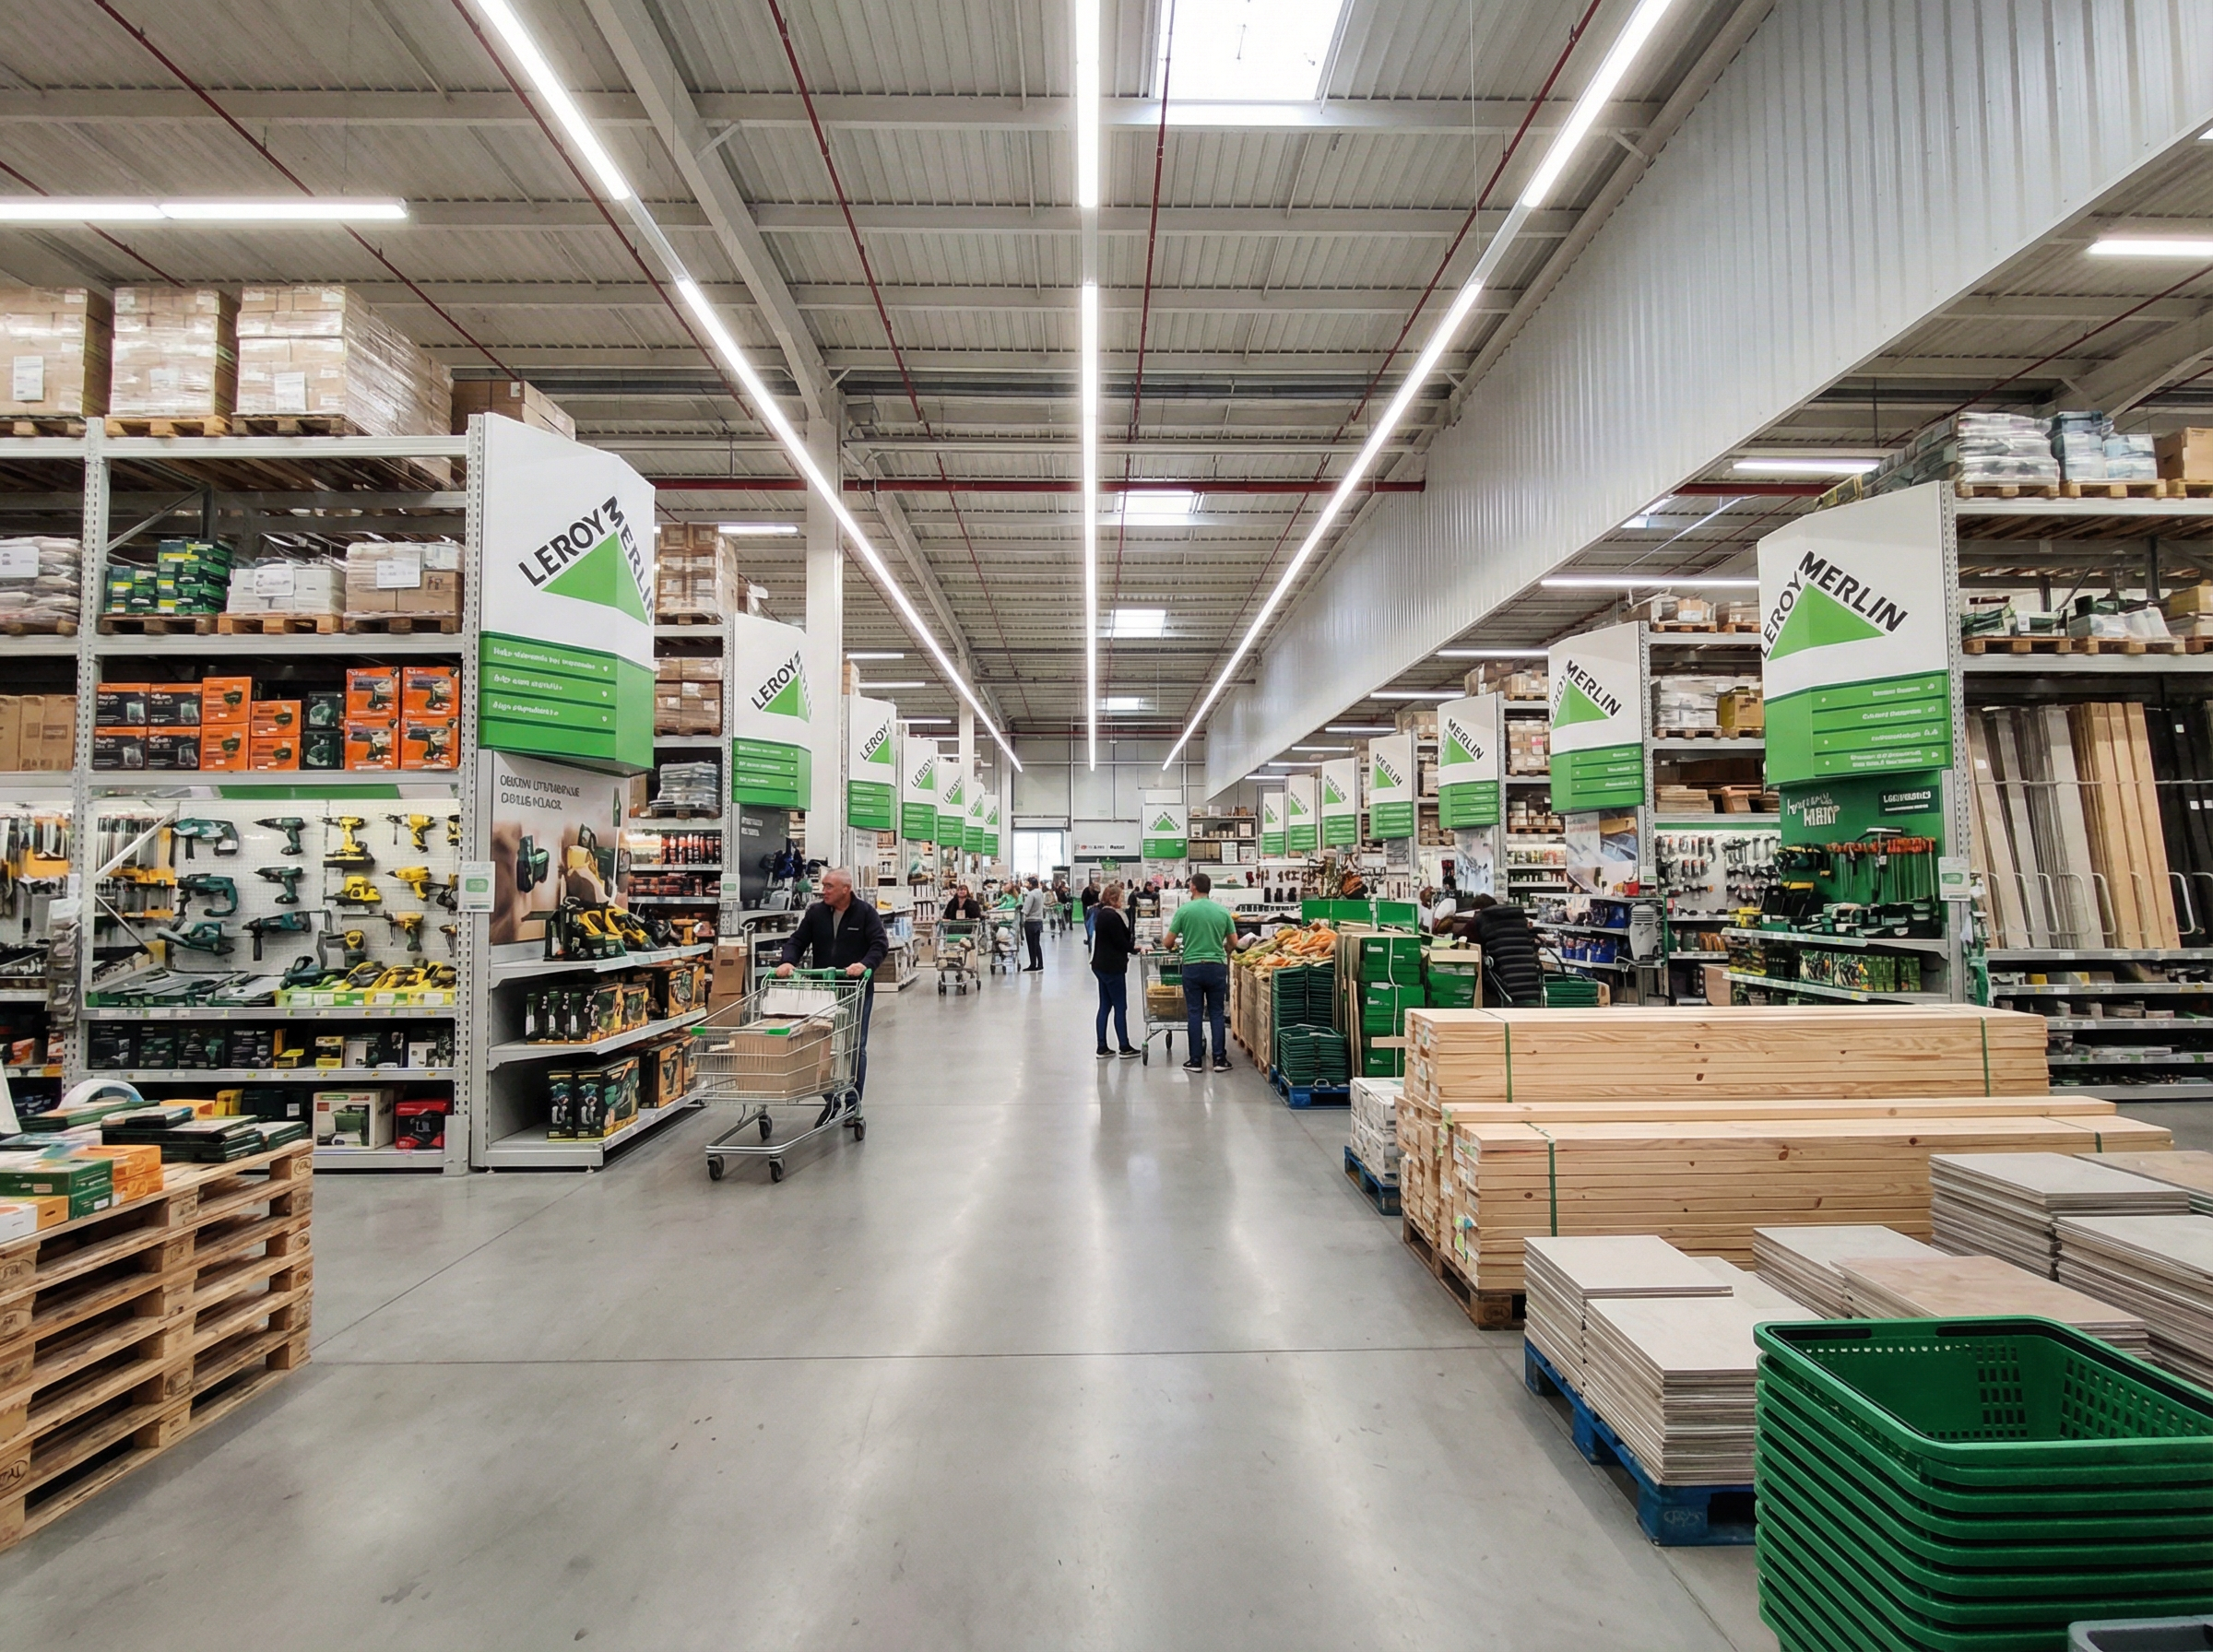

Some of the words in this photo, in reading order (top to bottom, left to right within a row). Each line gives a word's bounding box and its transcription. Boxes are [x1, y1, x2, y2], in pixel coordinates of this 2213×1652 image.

[518, 508, 606, 587] LEROY
[601, 495, 654, 620] MERLIN
[1760, 571, 1802, 658] LEROY
[1798, 550, 1909, 632] MERLIN
[751, 657, 797, 711] LEROY
[1567, 659, 1622, 717] MERLIN
[859, 724, 888, 761] LEROY
[1448, 718, 1485, 761] MERLIN
